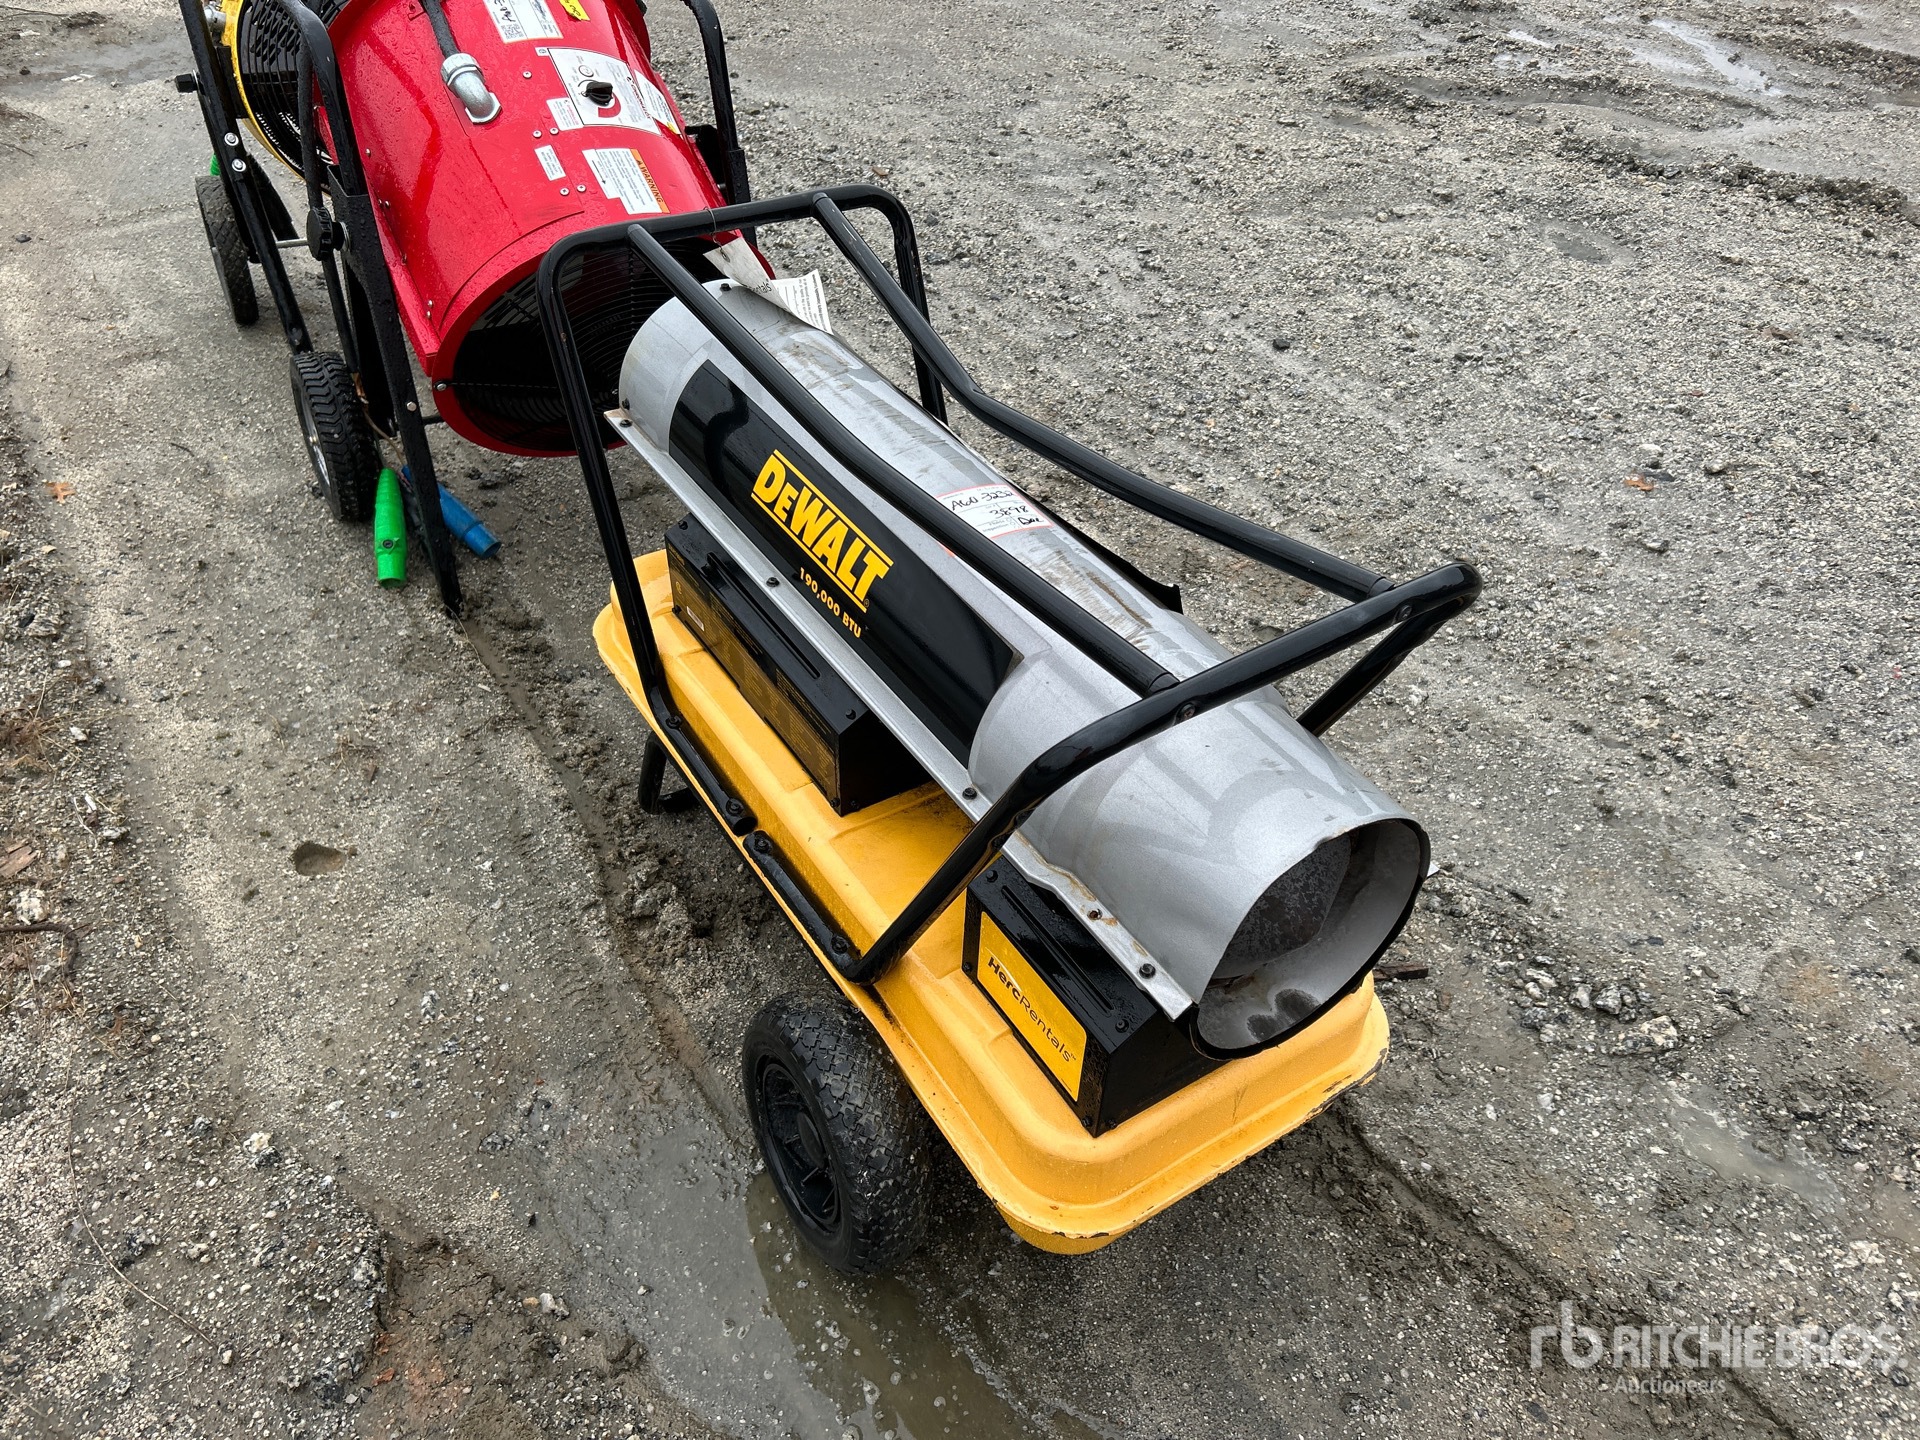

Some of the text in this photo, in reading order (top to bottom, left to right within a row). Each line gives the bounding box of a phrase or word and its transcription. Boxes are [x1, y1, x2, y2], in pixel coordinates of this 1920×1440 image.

[640, 165, 664, 203] WARNING
[799, 566, 862, 638] 190,000 BTU
